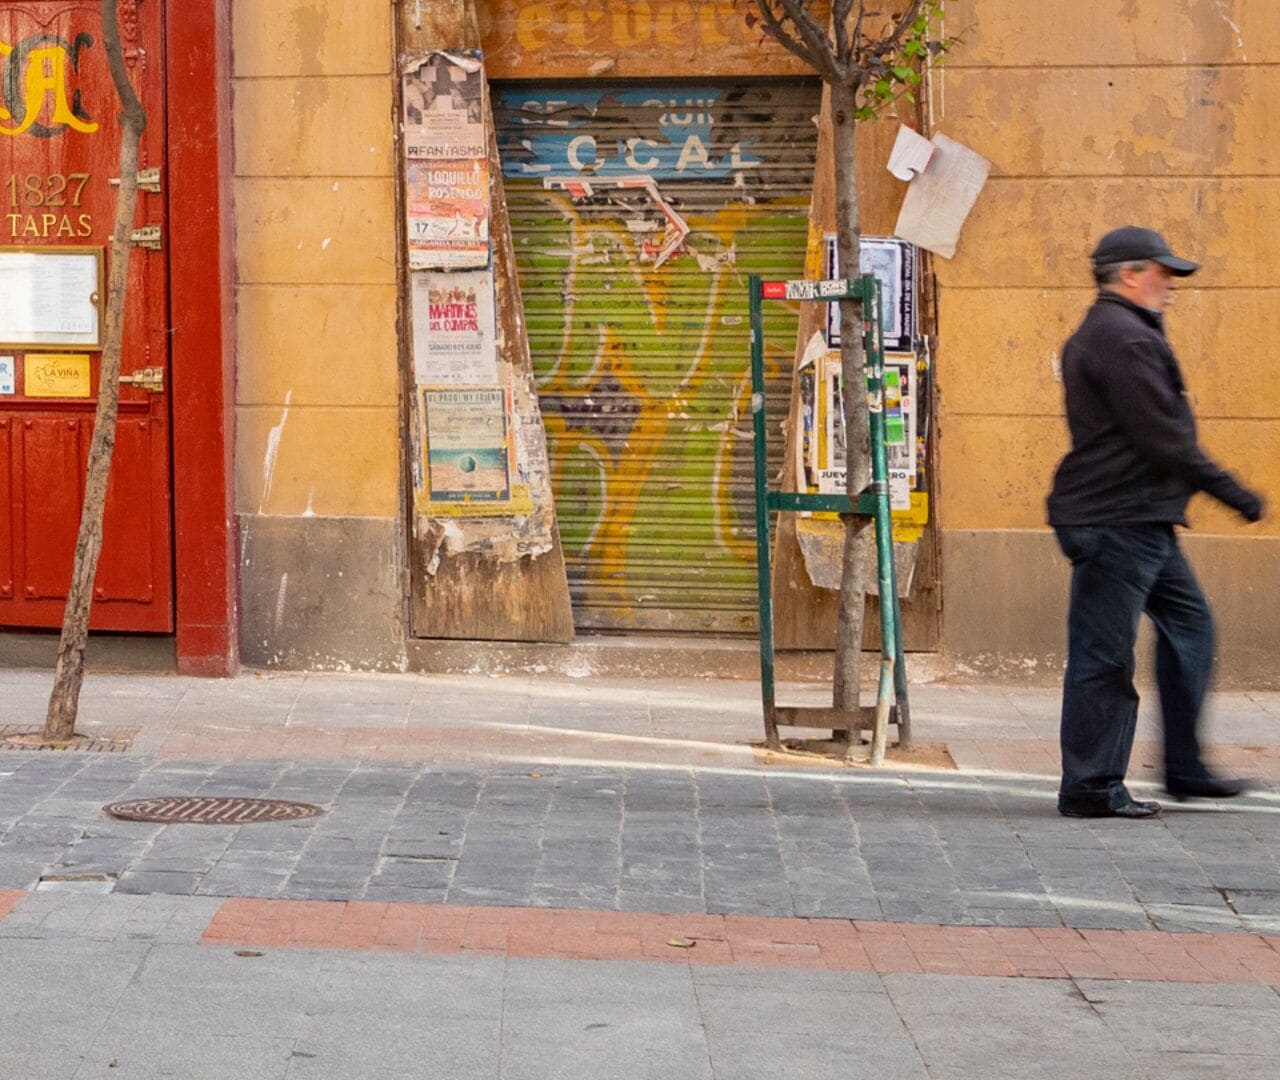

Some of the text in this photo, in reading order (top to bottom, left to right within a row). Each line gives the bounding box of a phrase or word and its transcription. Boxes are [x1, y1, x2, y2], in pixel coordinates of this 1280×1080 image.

[6, 173, 92, 208] 1827
[6, 213, 92, 238] TAPAS
[416, 223, 429, 233] 17
